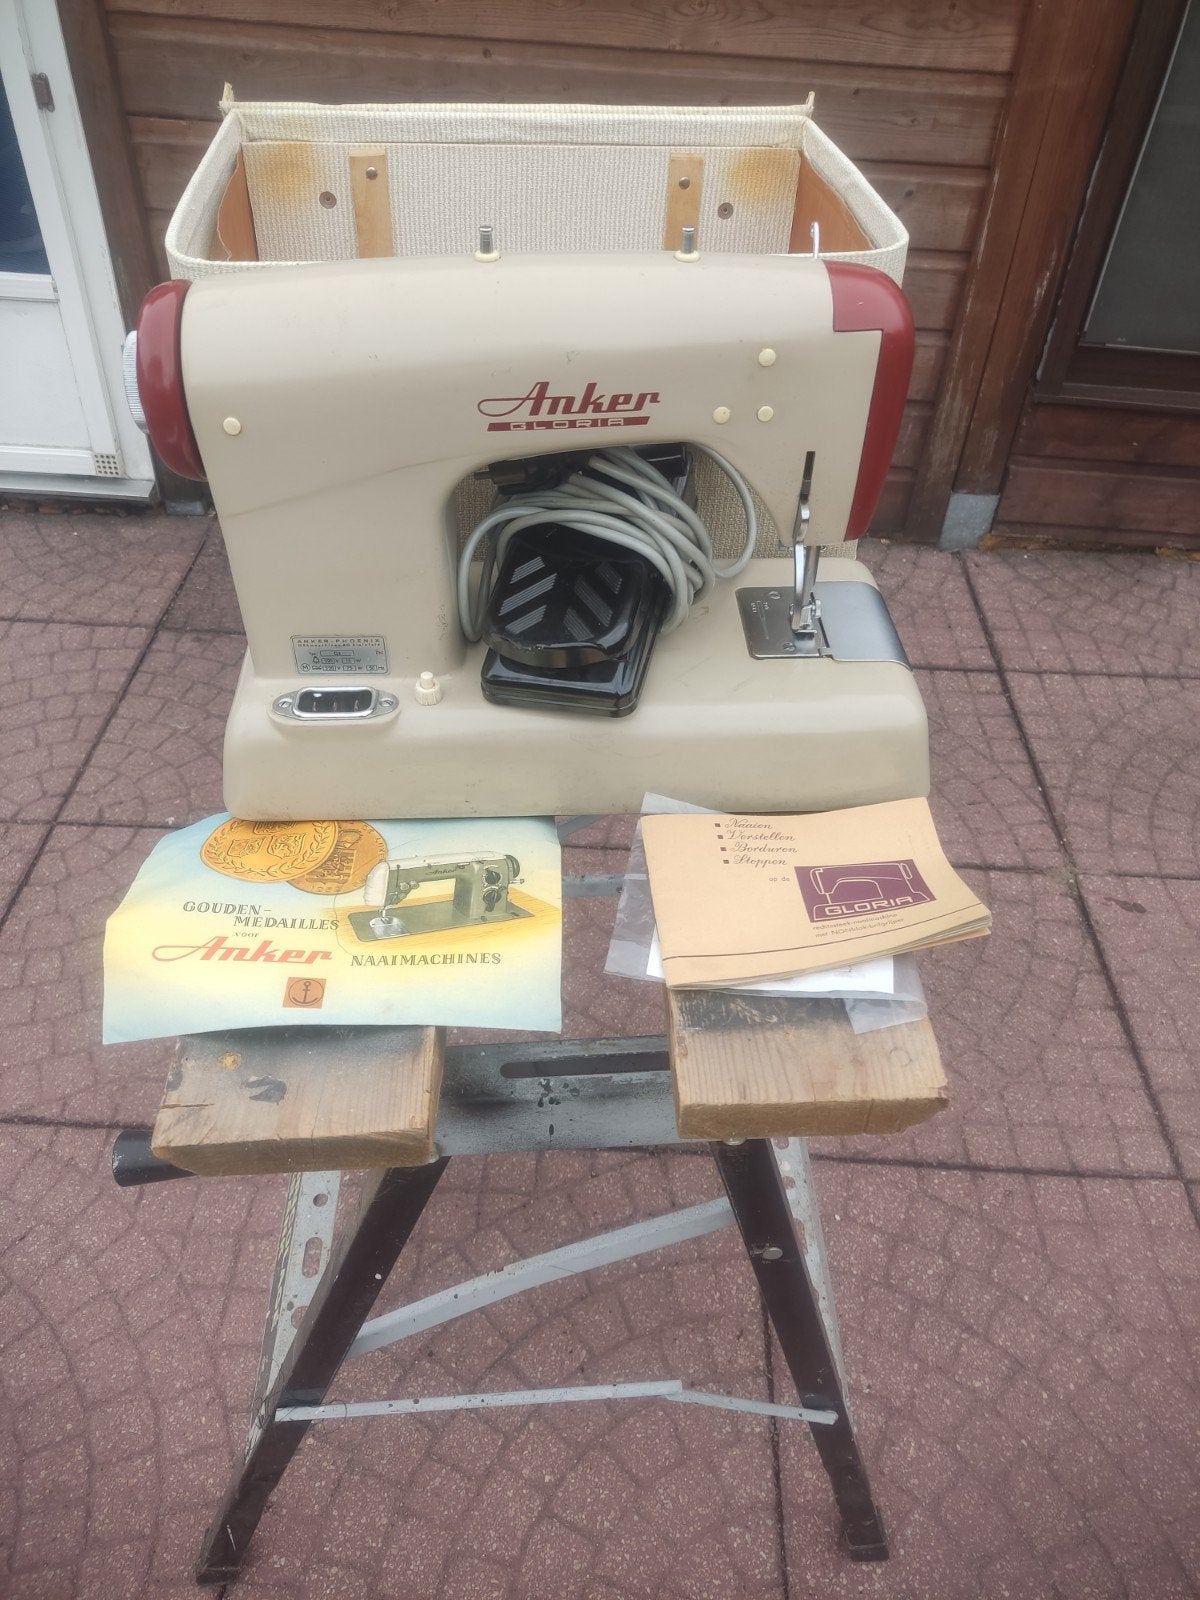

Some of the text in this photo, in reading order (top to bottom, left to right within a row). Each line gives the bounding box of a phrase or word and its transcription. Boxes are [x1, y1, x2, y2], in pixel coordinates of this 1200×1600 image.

[477, 381, 661, 417] Anker
[510, 418, 624, 431] GLORIA
[724, 817, 773, 829] Naaien
[727, 830, 795, 841] Verstellen
[733, 854, 788, 868] Stoppen
[182, 901, 272, 915] GOUDEN-
[824, 896, 913, 916] GLORIA
[233, 915, 340, 931] MEDAILLES
[151, 936, 333, 964] Anker
[350, 952, 501, 966] NAAIMACHINES
